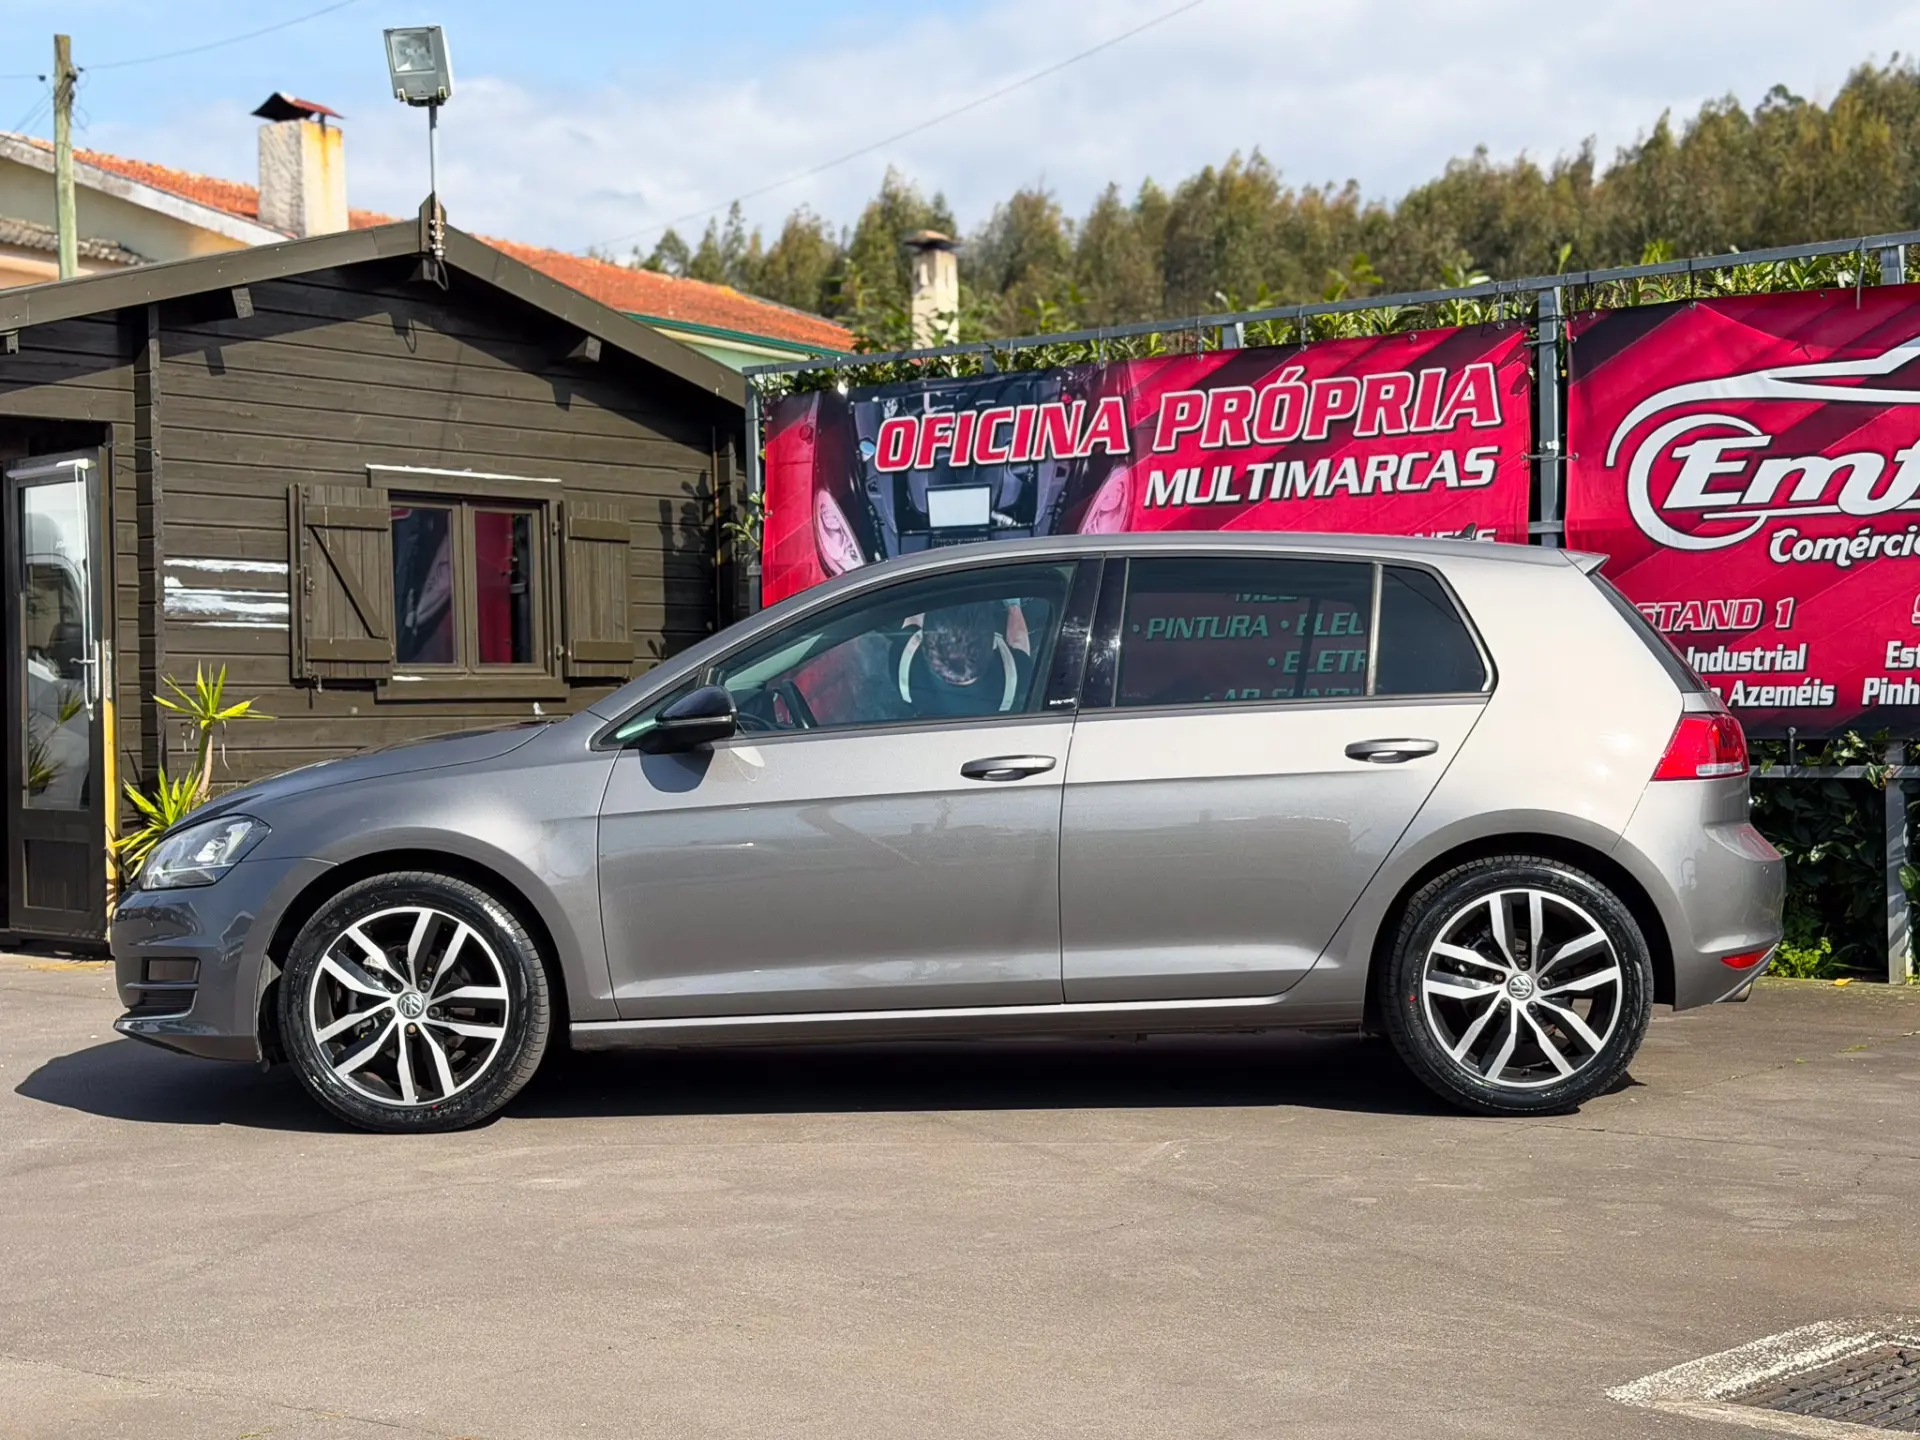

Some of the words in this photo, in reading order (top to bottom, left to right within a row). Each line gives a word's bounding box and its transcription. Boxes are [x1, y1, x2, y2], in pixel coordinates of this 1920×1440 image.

[874, 397, 1130, 472] OFICINA
[1152, 362, 1501, 452] PRÓPRIA
[1144, 446, 1499, 507] MULTIMARCAS
[1146, 614, 1269, 640] PINTURA
[1774, 597, 1796, 629] 1
[1686, 643, 1807, 673] Industrial
[1727, 677, 1836, 707] Azeméis
